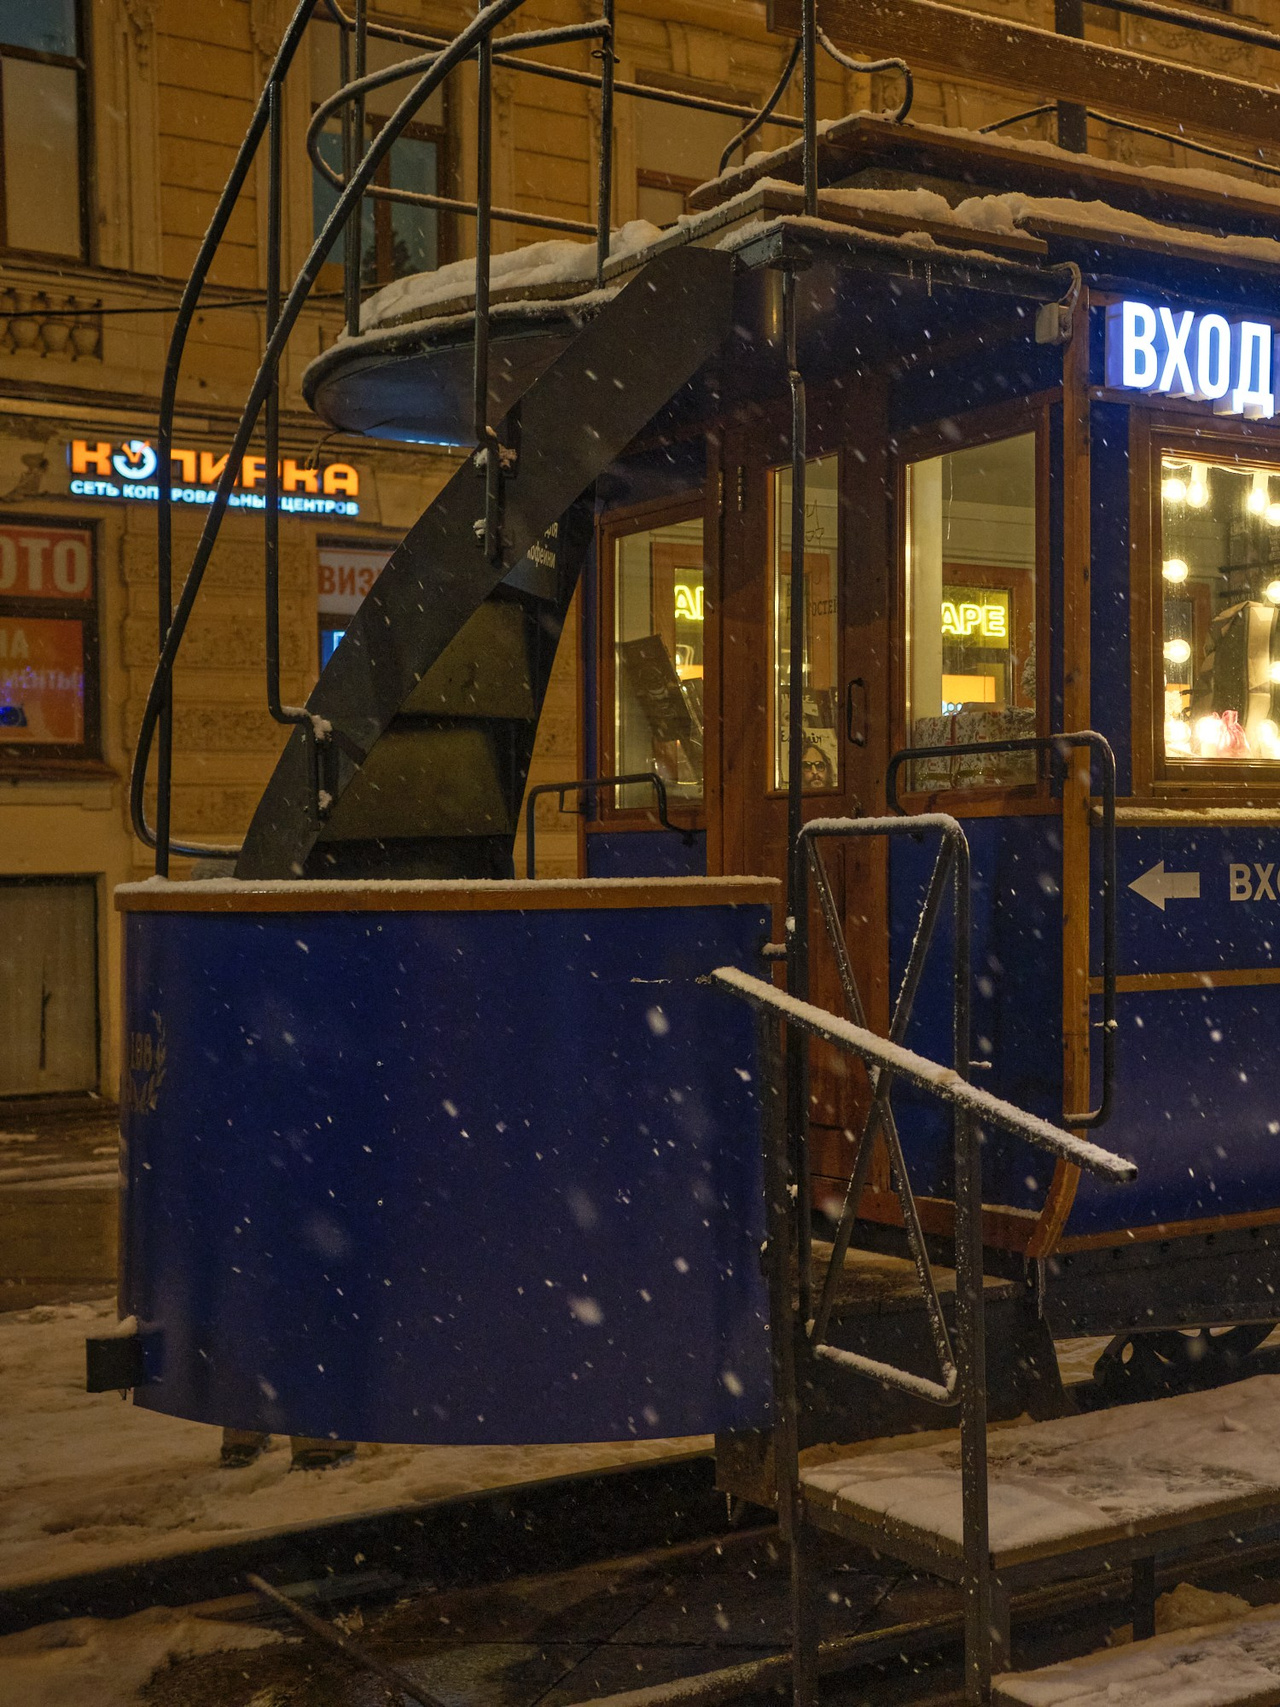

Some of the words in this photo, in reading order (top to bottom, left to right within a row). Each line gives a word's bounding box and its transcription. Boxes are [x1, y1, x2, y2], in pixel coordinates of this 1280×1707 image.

[1121, 300, 1275, 418] ВХОД
[70, 480, 120, 498] СЕТЬ
[281, 496, 360, 517] ЦЕНТРОВ
